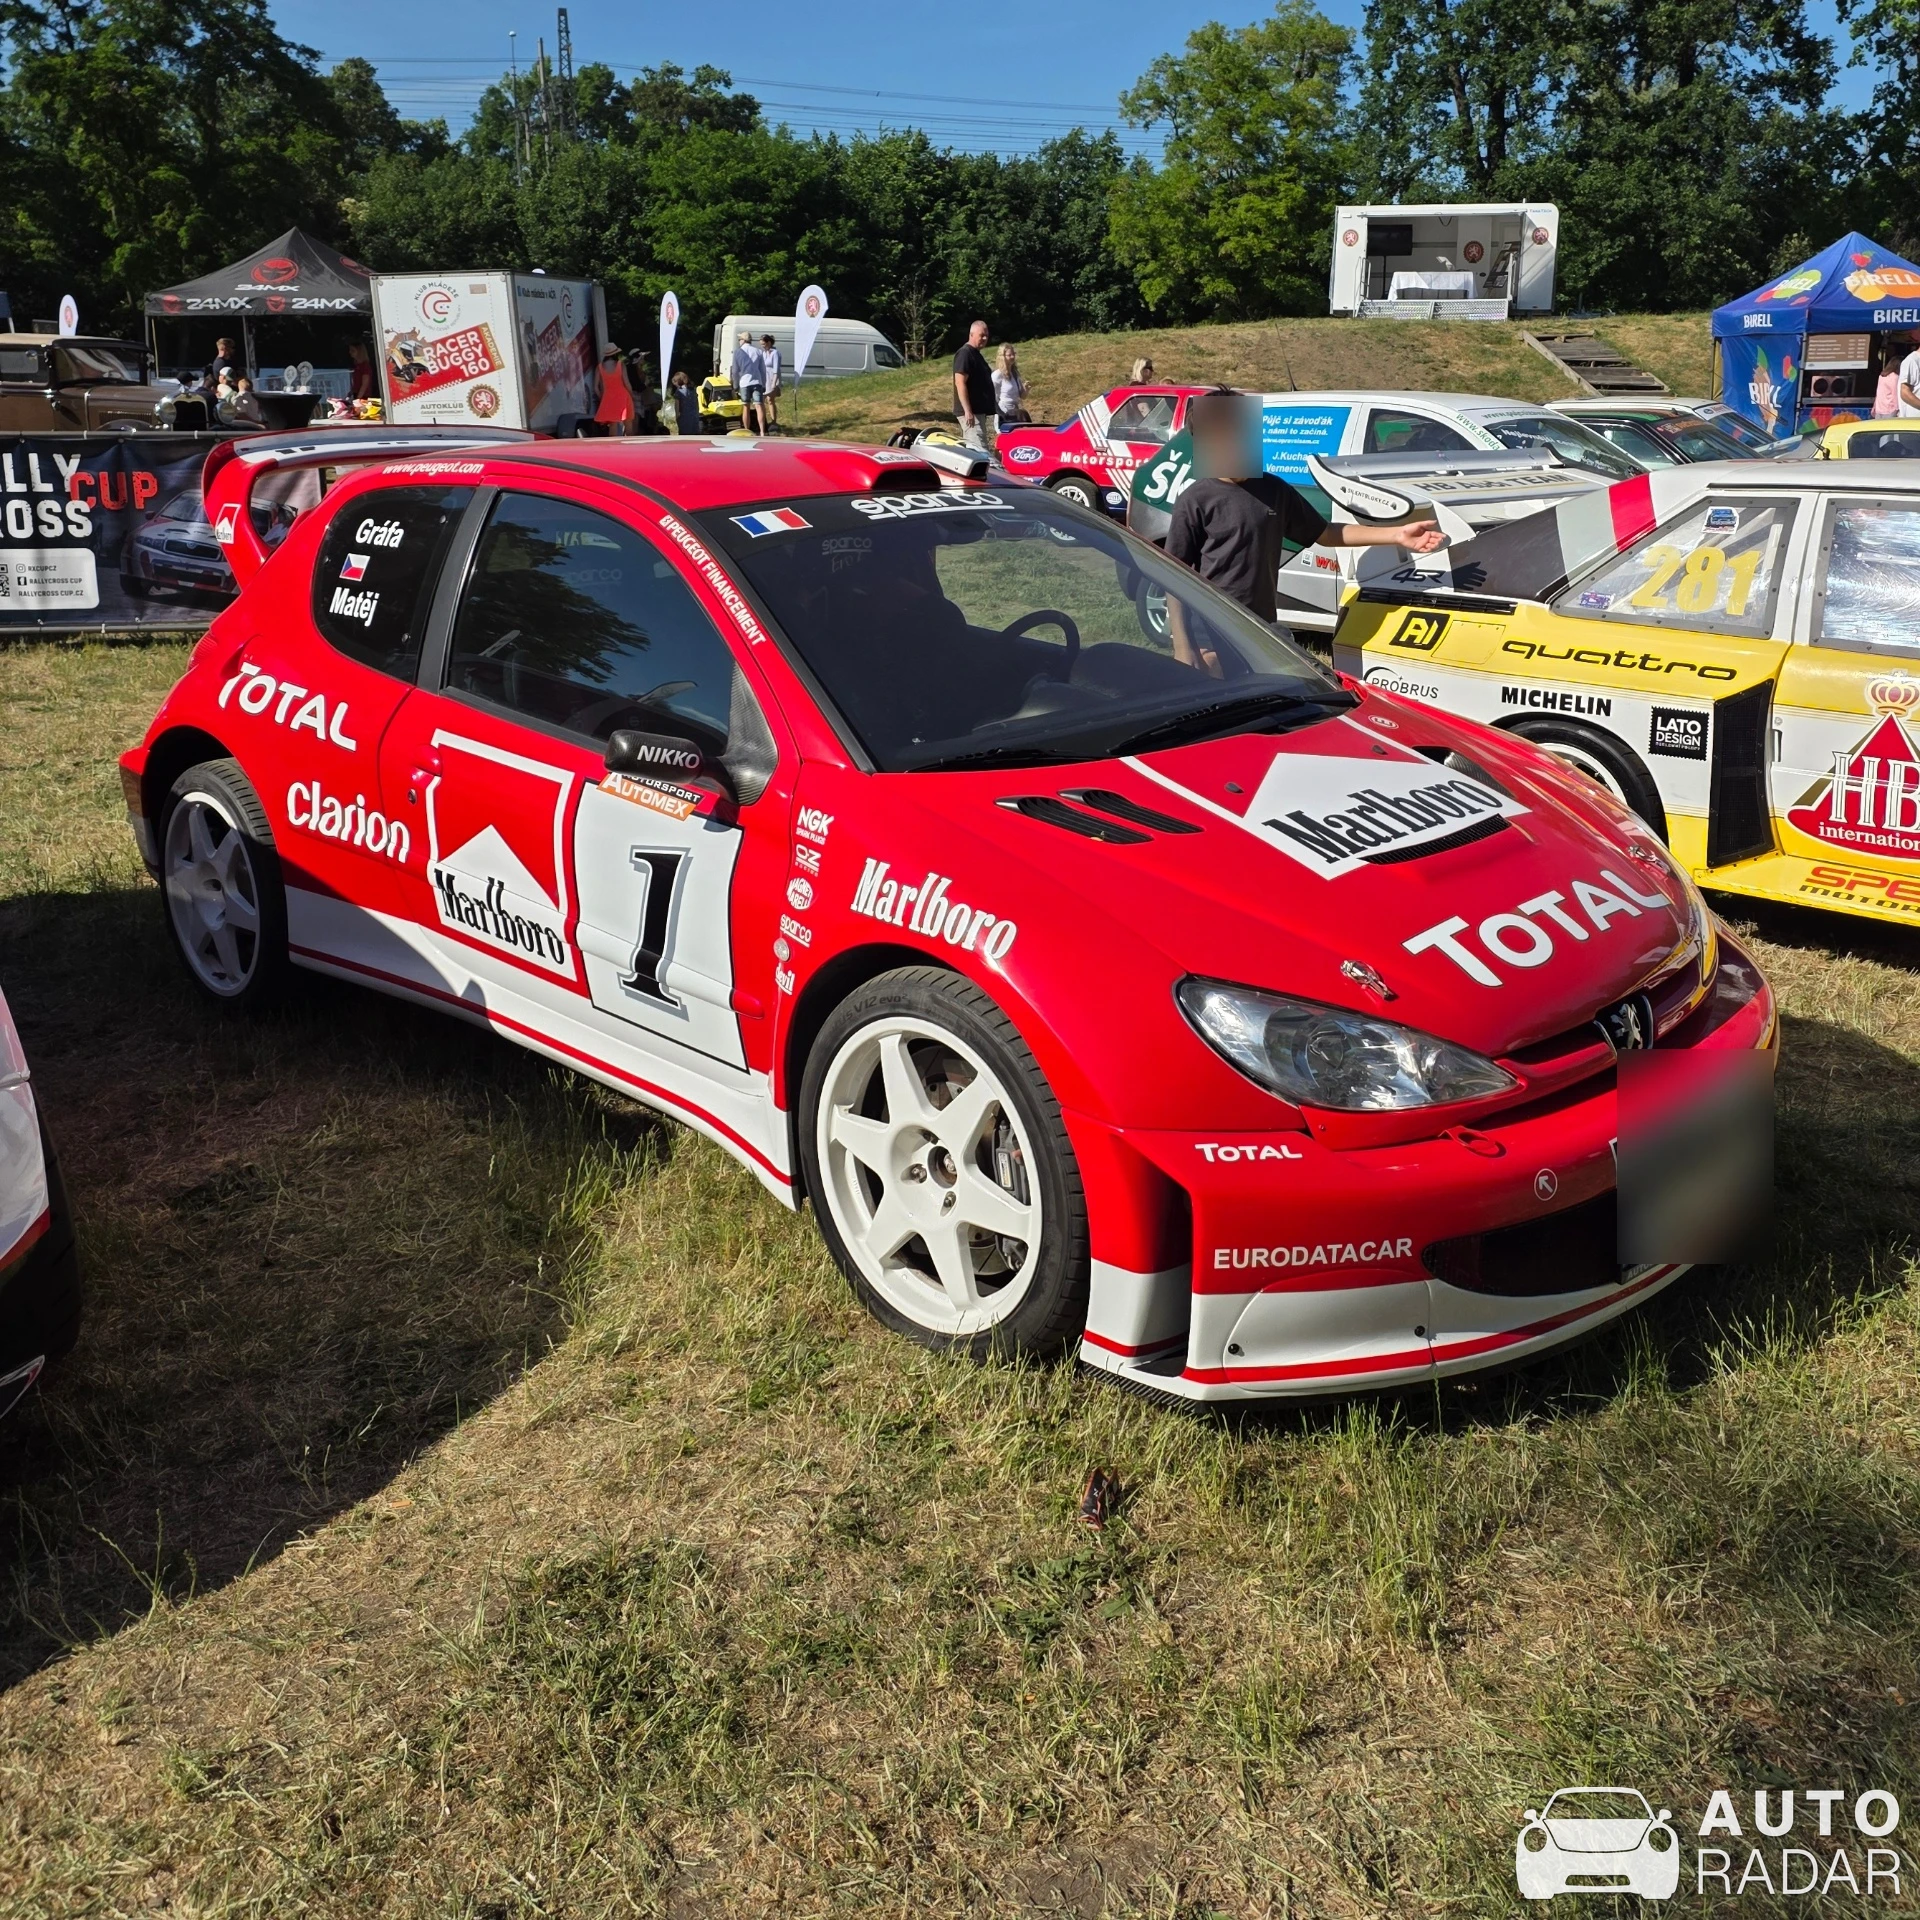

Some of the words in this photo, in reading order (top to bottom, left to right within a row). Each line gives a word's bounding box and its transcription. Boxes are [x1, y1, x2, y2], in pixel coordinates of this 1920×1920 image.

[186, 296, 252, 310] 24MX
[291, 297, 357, 310] 24MX
[234, 284, 300, 292] 24MX
[1743, 313, 1773, 329] BIRELL
[423, 331, 481, 361] RACER
[427, 344, 484, 375] BUGGY
[481, 326, 502, 365] AKADEMIE
[460, 358, 491, 378] 160
[382, 461, 485, 476] www.peugeot.com
[1014, 448, 1037, 462] Ford
[69, 471, 159, 511] CUP
[1412, 482, 1457, 492] HB
[1506, 473, 1574, 486] TEAM
[850, 491, 1005, 519] sparco
[355, 518, 405, 548] Gráfa
[29, 577, 69, 585] RALLYCROSS
[666, 519, 711, 566] PEUGEOT
[702, 562, 767, 646] FINANCEMENT
[1631, 544, 1761, 617] 281
[329, 587, 380, 628] Matěj
[1502, 639, 1738, 682] quattro
[1371, 677, 1439, 699] PROBRUS
[1501, 686, 1612, 718] MICHELIN
[218, 661, 357, 752] TOTAL
[1655, 731, 1702, 747] DESIGN
[1656, 716, 1702, 735] LATO
[637, 744, 700, 769] NIKKO
[602, 772, 690, 818] AUTOMEX
[1832, 751, 1920, 835] HB
[286, 780, 411, 863] Clarion
[797, 804, 835, 837] NGK
[1260, 778, 1502, 865] Marlboro
[795, 843, 822, 868] OZ
[433, 866, 565, 965] Marlboro
[850, 857, 1019, 961] Marlboro
[617, 844, 694, 1021] 1
[780, 914, 812, 943] sparco
[1401, 869, 1671, 988] TOTAL
[775, 962, 796, 993] devil
[854, 995, 878, 1013] V12
[1194, 1142, 1304, 1163] TOTAL
[1213, 1236, 1413, 1270] EURODATACAR
